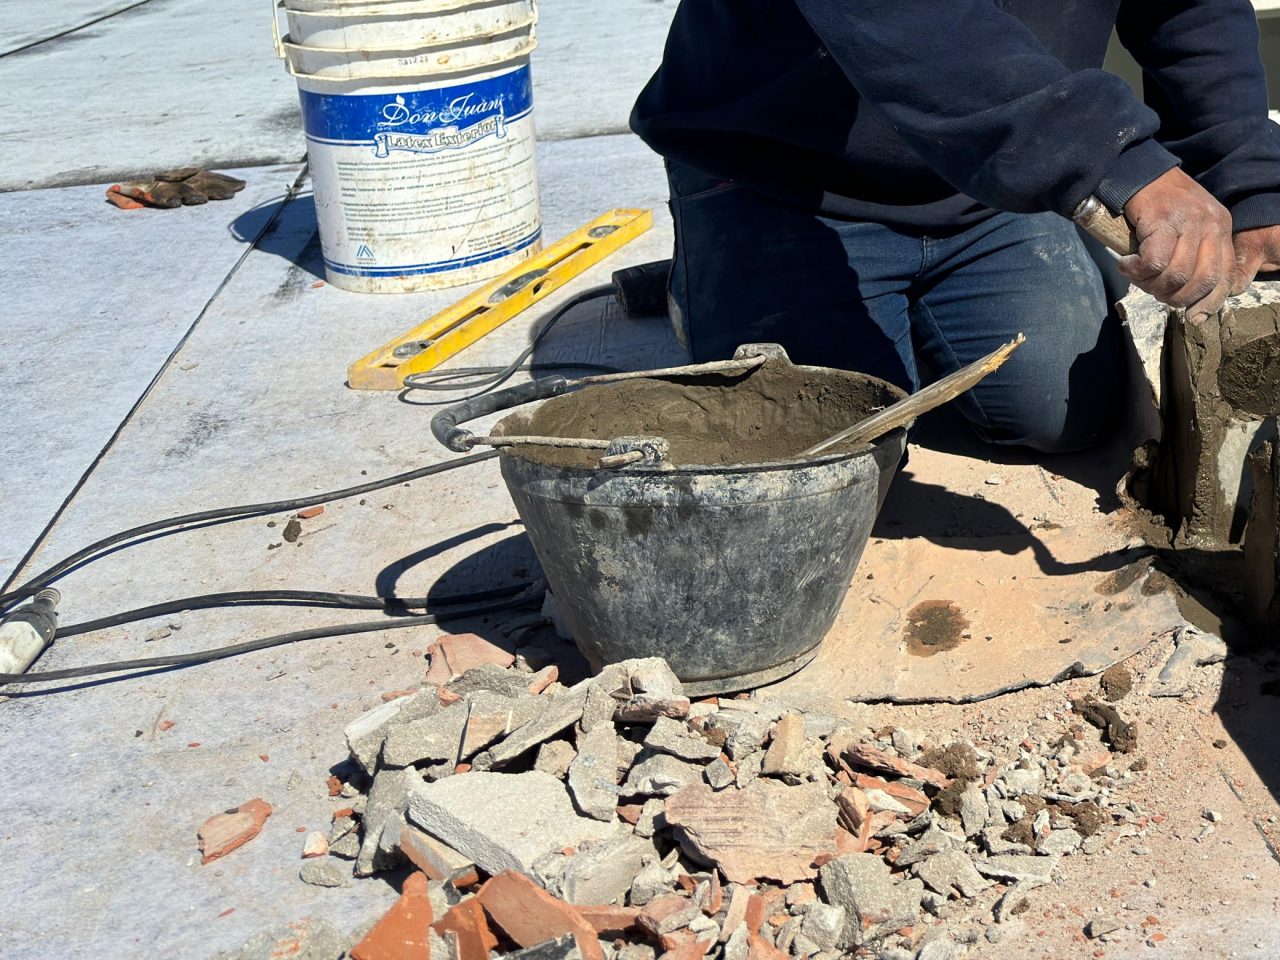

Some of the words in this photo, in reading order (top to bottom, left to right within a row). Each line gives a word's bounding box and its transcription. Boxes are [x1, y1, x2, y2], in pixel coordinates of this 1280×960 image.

[377, 101, 438, 126] Don
[439, 92, 501, 122] Juan
[387, 136, 432, 149] Latex
[434, 120, 497, 146] Exterior
